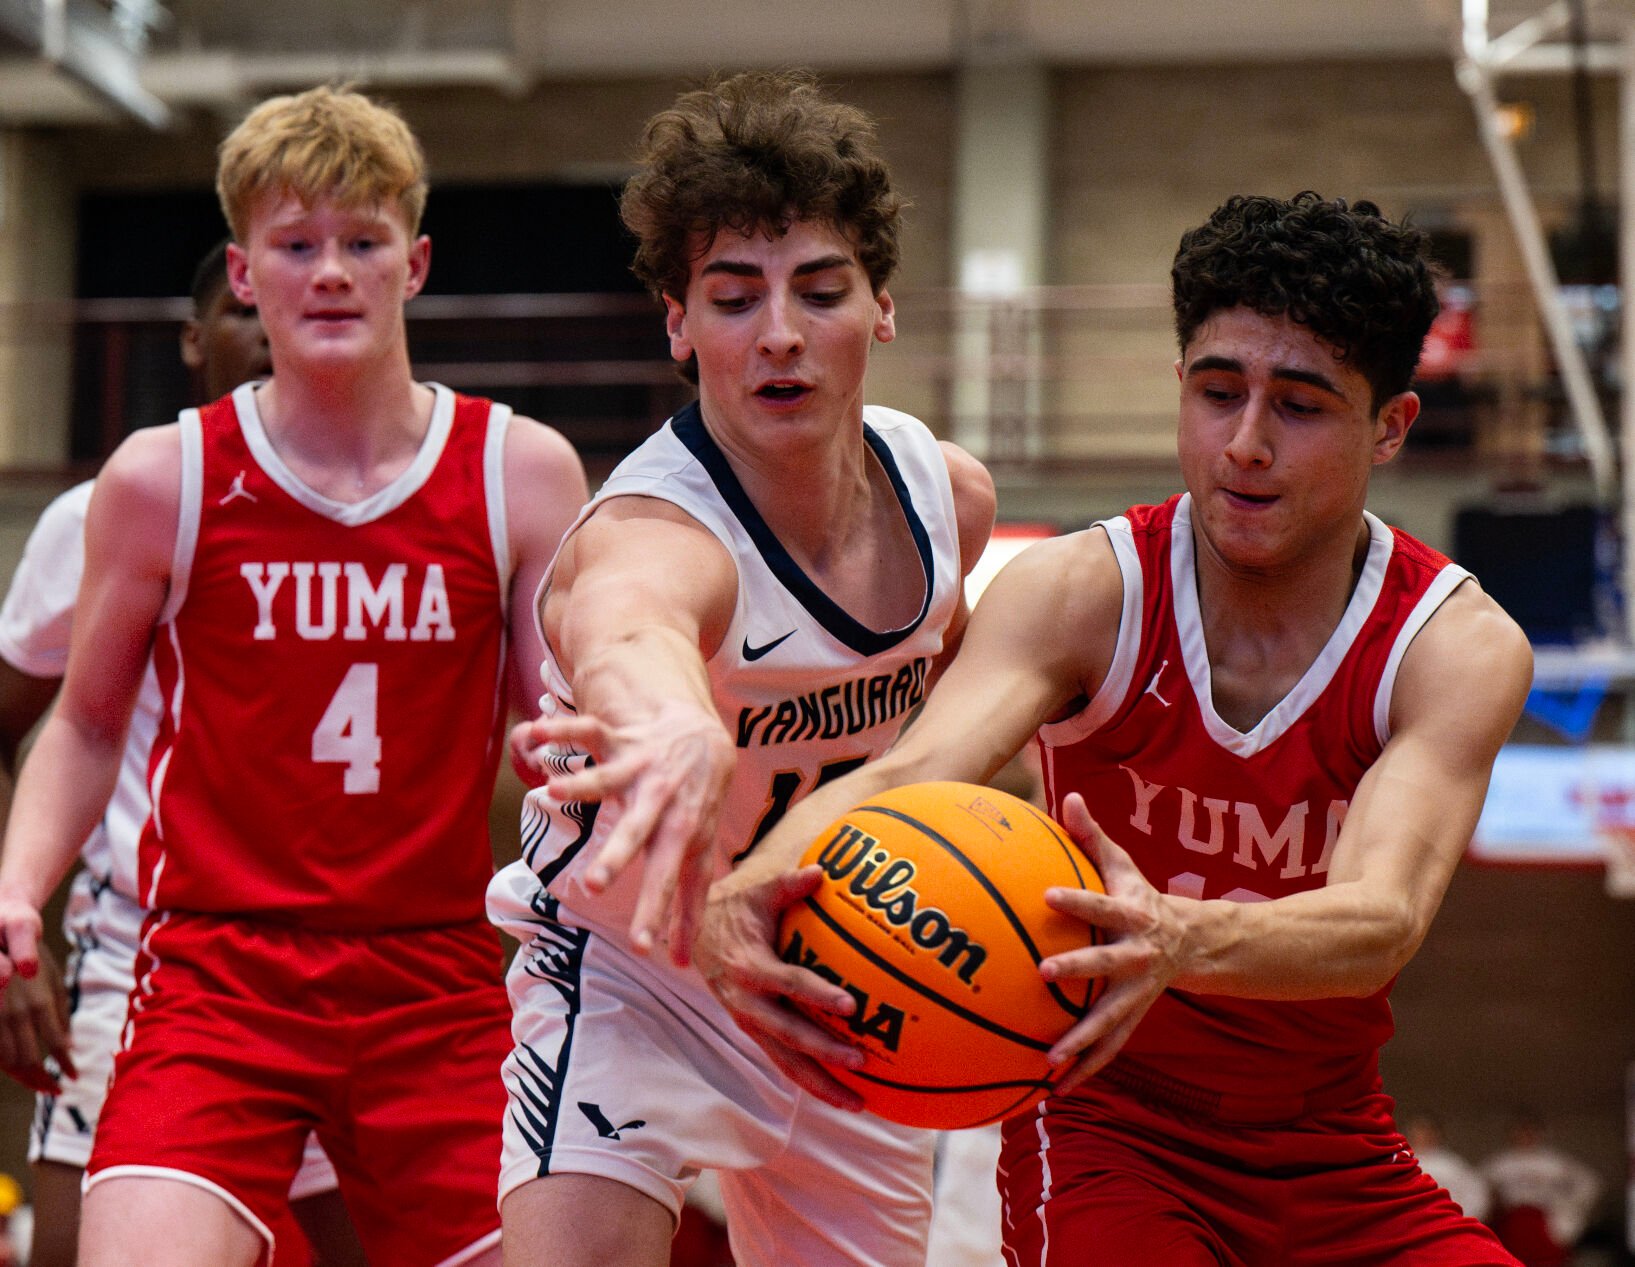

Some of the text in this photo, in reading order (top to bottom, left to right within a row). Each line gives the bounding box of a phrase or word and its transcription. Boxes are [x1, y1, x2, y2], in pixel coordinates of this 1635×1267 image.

[240, 561, 456, 641] YUMA
[311, 662, 382, 795] 4
[736, 657, 926, 748] VANGUARD
[732, 752, 870, 864] 1
[817, 823, 988, 985] Wilson
